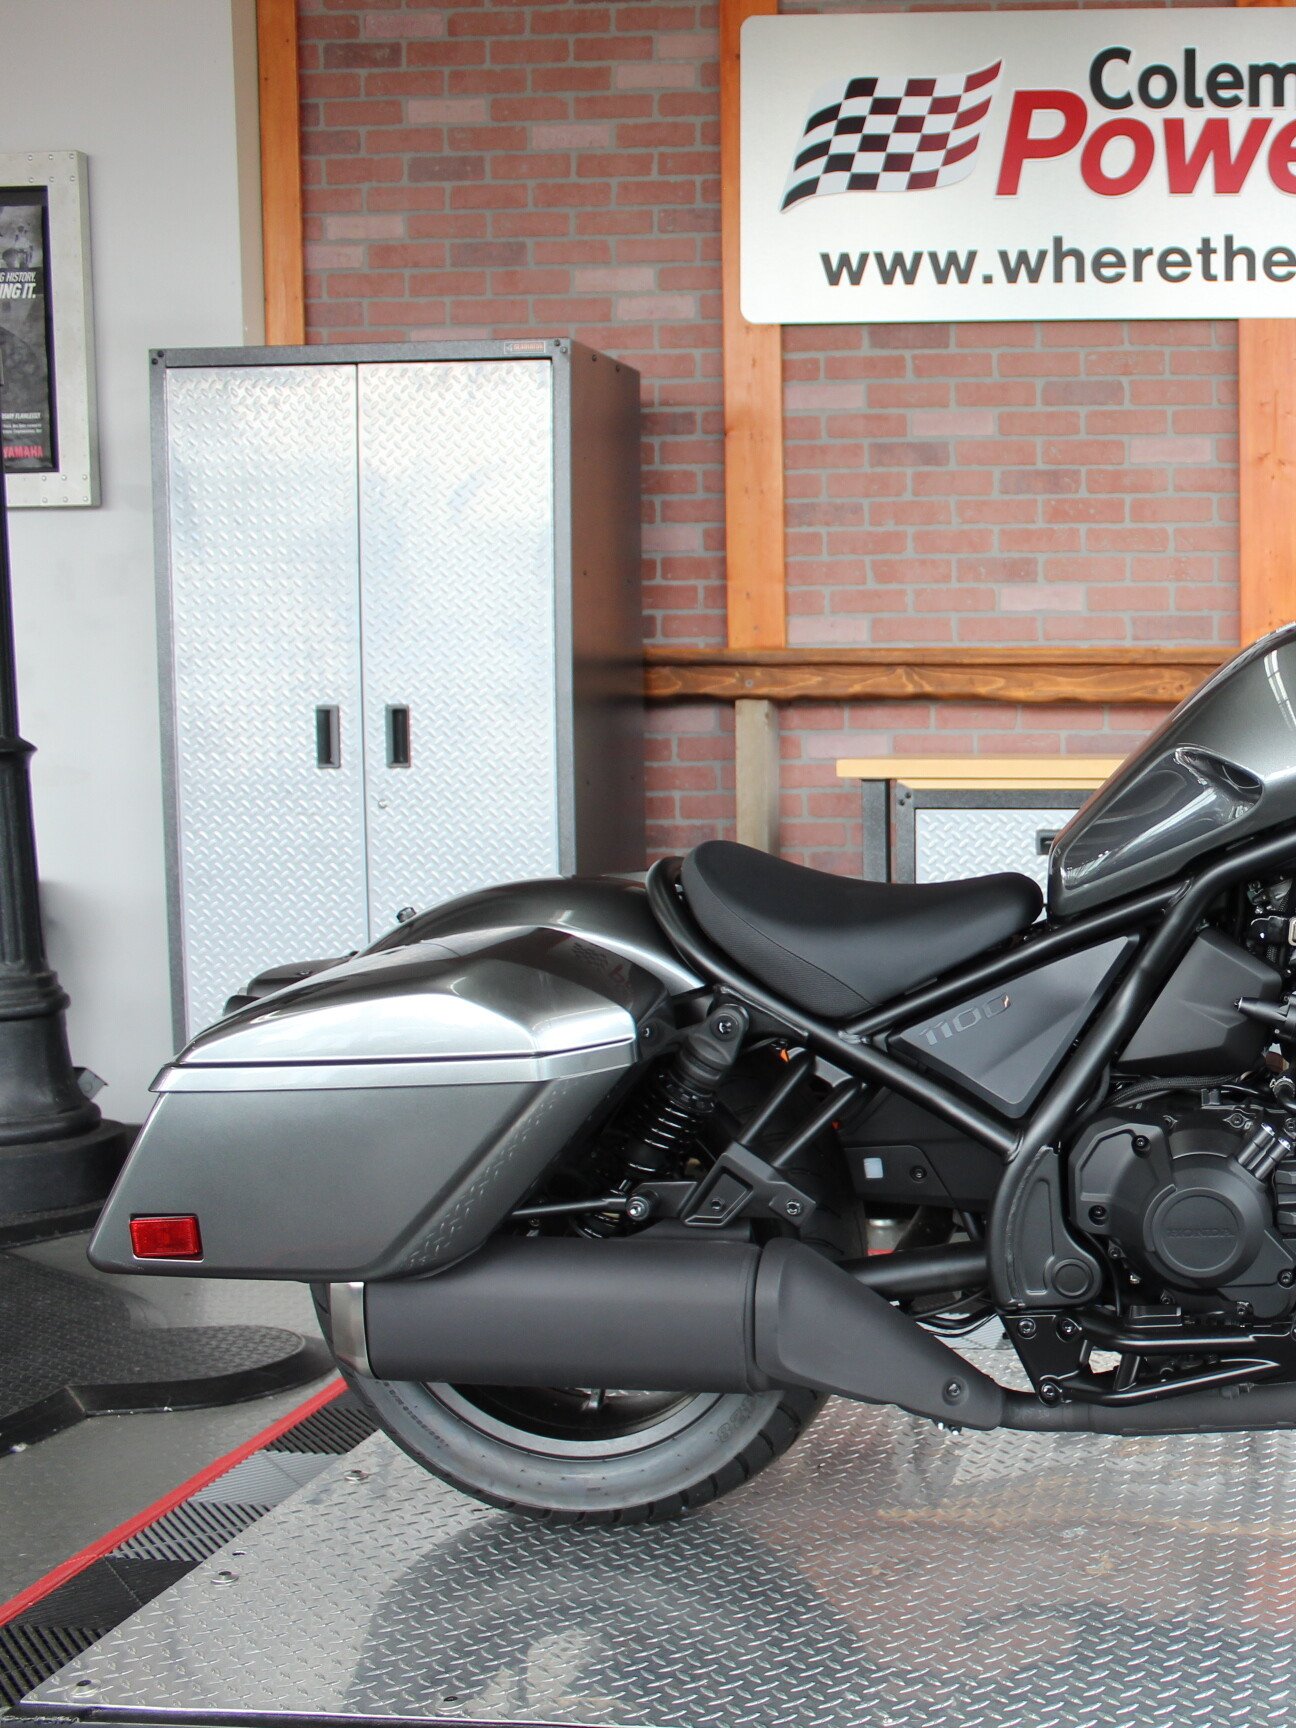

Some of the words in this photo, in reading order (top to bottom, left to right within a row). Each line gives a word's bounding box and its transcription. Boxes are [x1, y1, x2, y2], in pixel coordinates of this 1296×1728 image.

[6, 271, 36, 282] HISTORY.
[22, 282, 36, 299] IT.
[3, 445, 43, 459] YAMAHA
[919, 993, 1011, 1046] 1100
